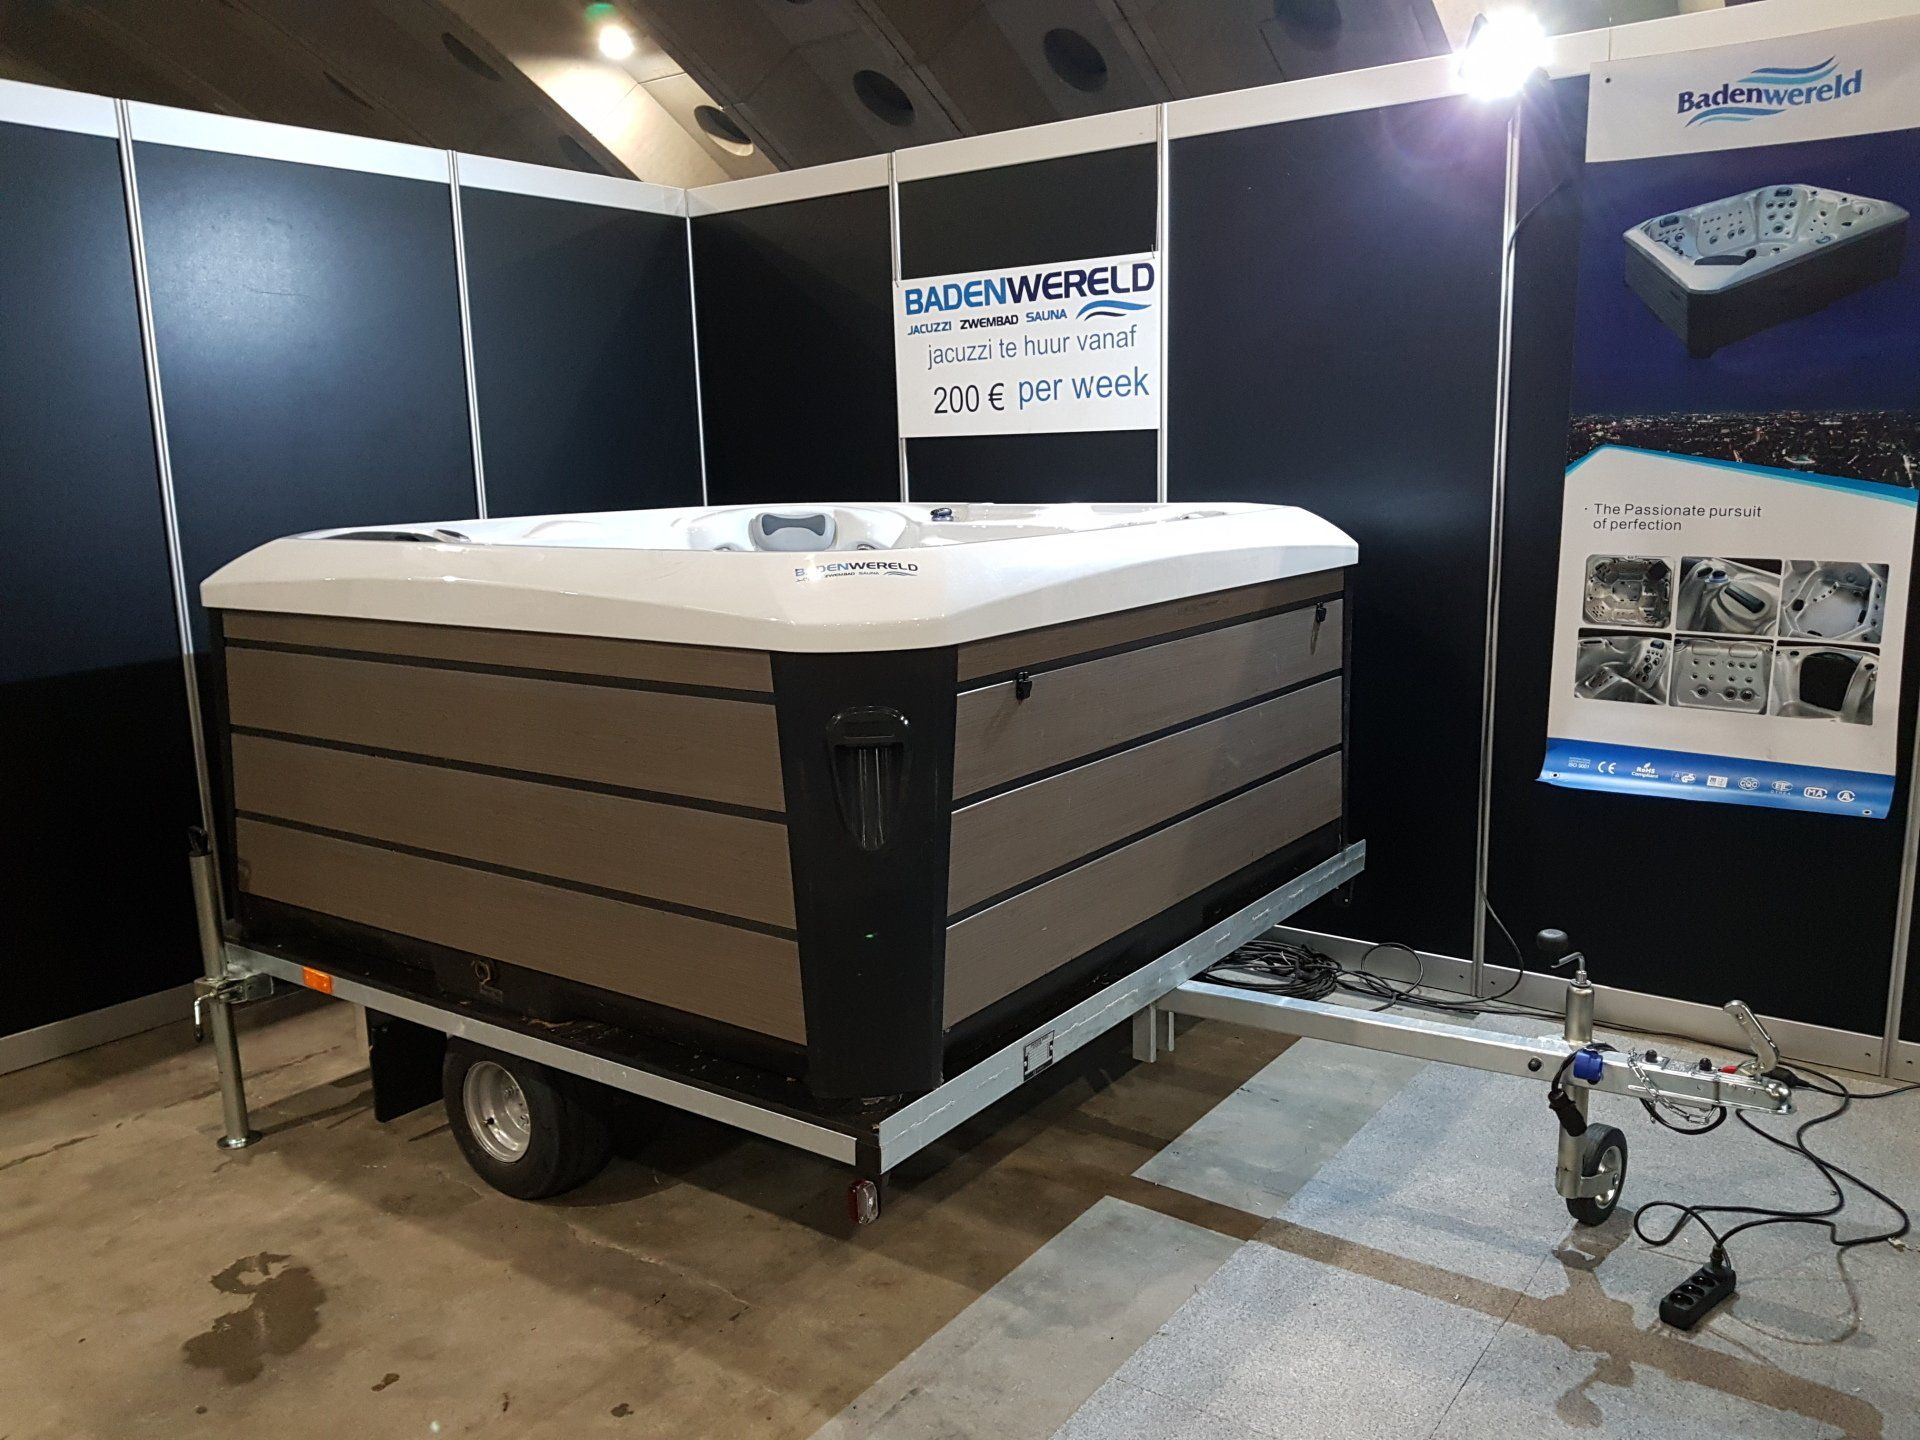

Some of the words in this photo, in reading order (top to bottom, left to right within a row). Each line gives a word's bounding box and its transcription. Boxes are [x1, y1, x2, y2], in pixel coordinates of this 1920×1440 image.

[1677, 69, 1863, 114] Badenwereld
[905, 262, 1155, 315] BADENWERELD
[907, 321, 952, 335] JACUZZI
[960, 314, 1019, 330] ZWEMBAD
[1026, 309, 1067, 323] SAUNA
[927, 339, 992, 370] jacuzzi
[1000, 340, 1017, 359] te
[1024, 335, 1070, 356] huur
[1077, 324, 1138, 351] vanaf
[933, 384, 979, 414] 200
[988, 382, 1005, 411] €
[1019, 378, 1062, 410] per
[1072, 366, 1150, 399] week
[1593, 518, 1607, 530] of
[1610, 519, 1682, 531] perfection
[1594, 503, 1621, 515] The
[1624, 503, 1706, 517] Passionate
[1709, 505, 1762, 519] pursuit
[795, 561, 918, 577] BDENWERELD
